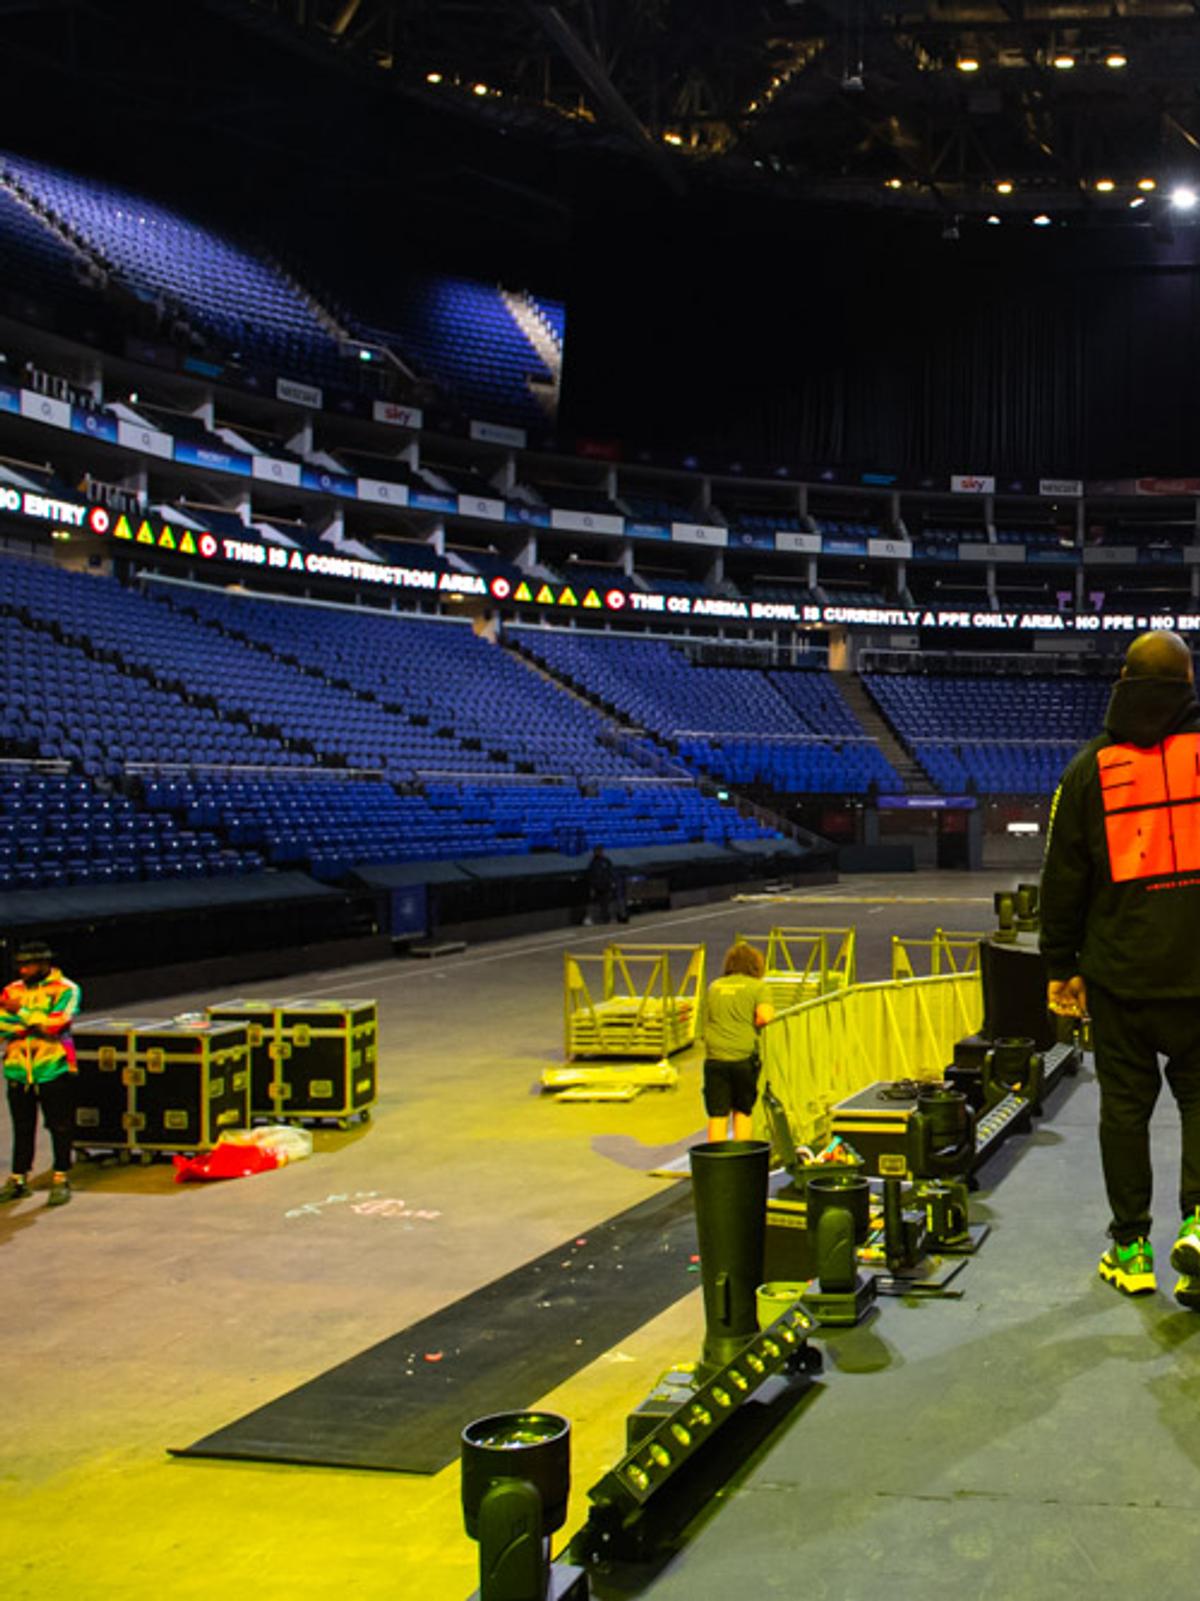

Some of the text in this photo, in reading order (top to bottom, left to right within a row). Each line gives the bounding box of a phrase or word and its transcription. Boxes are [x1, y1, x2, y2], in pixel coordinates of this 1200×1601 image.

[961, 476, 985, 492] sky
[24, 494, 85, 525] ENTRY
[224, 540, 487, 594] THIS IS A CONSTRUCTION AREA
[630, 594, 663, 610] THE
[693, 600, 747, 616] ARENA
[752, 603, 800, 619] BOWL
[804, 606, 820, 620] IS
[824, 608, 919, 625] CURRENTLY
[923, 613, 935, 625] A
[939, 613, 970, 626] PPE
[973, 614, 1017, 627] ONLY
[1020, 615, 1064, 628] AREA
[1076, 616, 1099, 629] NO
[1103, 616, 1133, 629] PPE
[1151, 616, 1174, 629] NO
